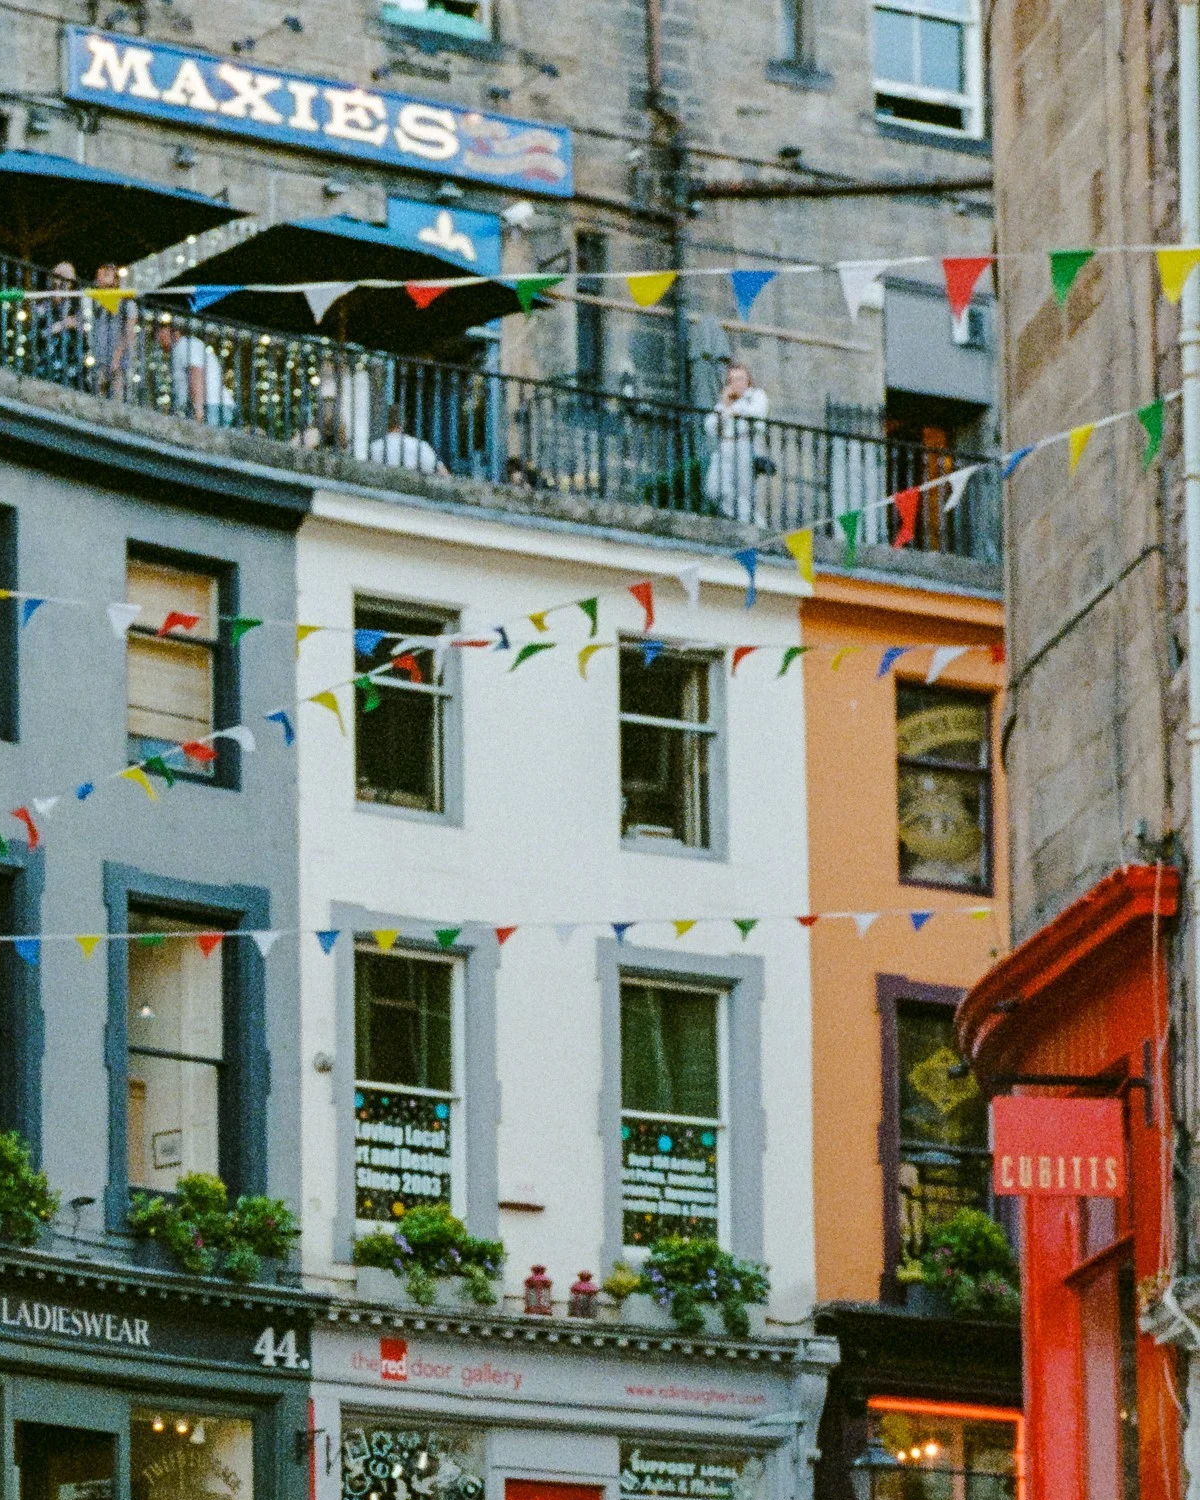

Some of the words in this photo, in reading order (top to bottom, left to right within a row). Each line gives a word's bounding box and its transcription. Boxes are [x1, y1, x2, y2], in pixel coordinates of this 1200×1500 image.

[80, 34, 460, 160] MAXIES
[405, 1124, 446, 1149] Local
[371, 1147, 399, 1168] and
[1000, 1155, 1117, 1189] CUBITTS
[357, 1167, 400, 1192] Since
[402, 1172, 441, 1197] 2003
[1, 1297, 150, 1346] LADIESWEAR
[352, 1351, 380, 1372] the
[381, 1353, 407, 1374] red
[410, 1353, 452, 1378] door
[461, 1360, 522, 1390] gallery
